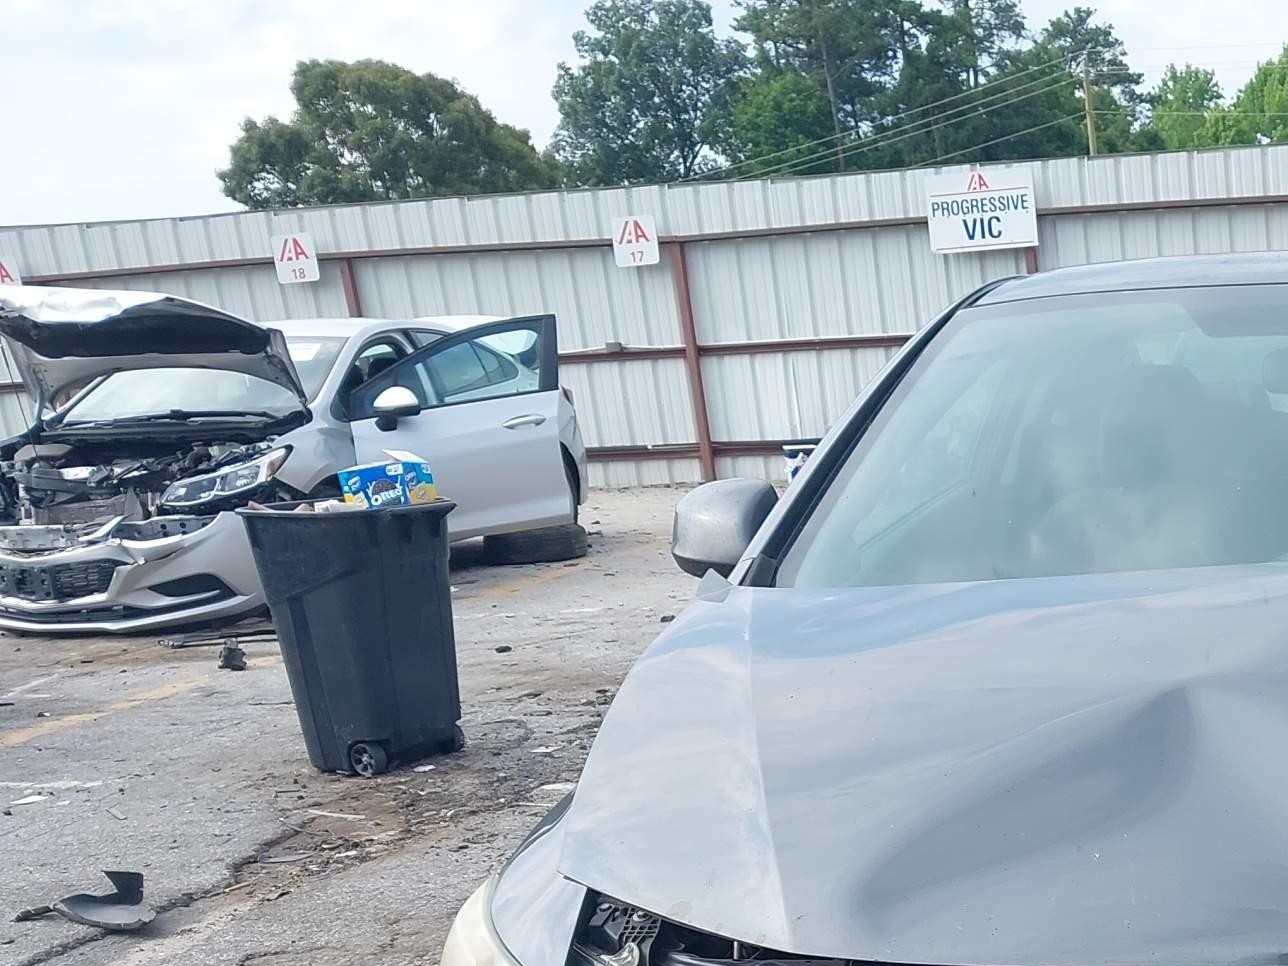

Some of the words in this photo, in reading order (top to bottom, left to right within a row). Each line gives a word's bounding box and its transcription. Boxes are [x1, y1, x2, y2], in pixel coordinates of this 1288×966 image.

[931, 193, 1029, 218] PROGRESSIVE
[961, 215, 1003, 241] VIC
[629, 250, 644, 263] 17
[291, 267, 306, 280] 18
[371, 487, 402, 506] OREO
